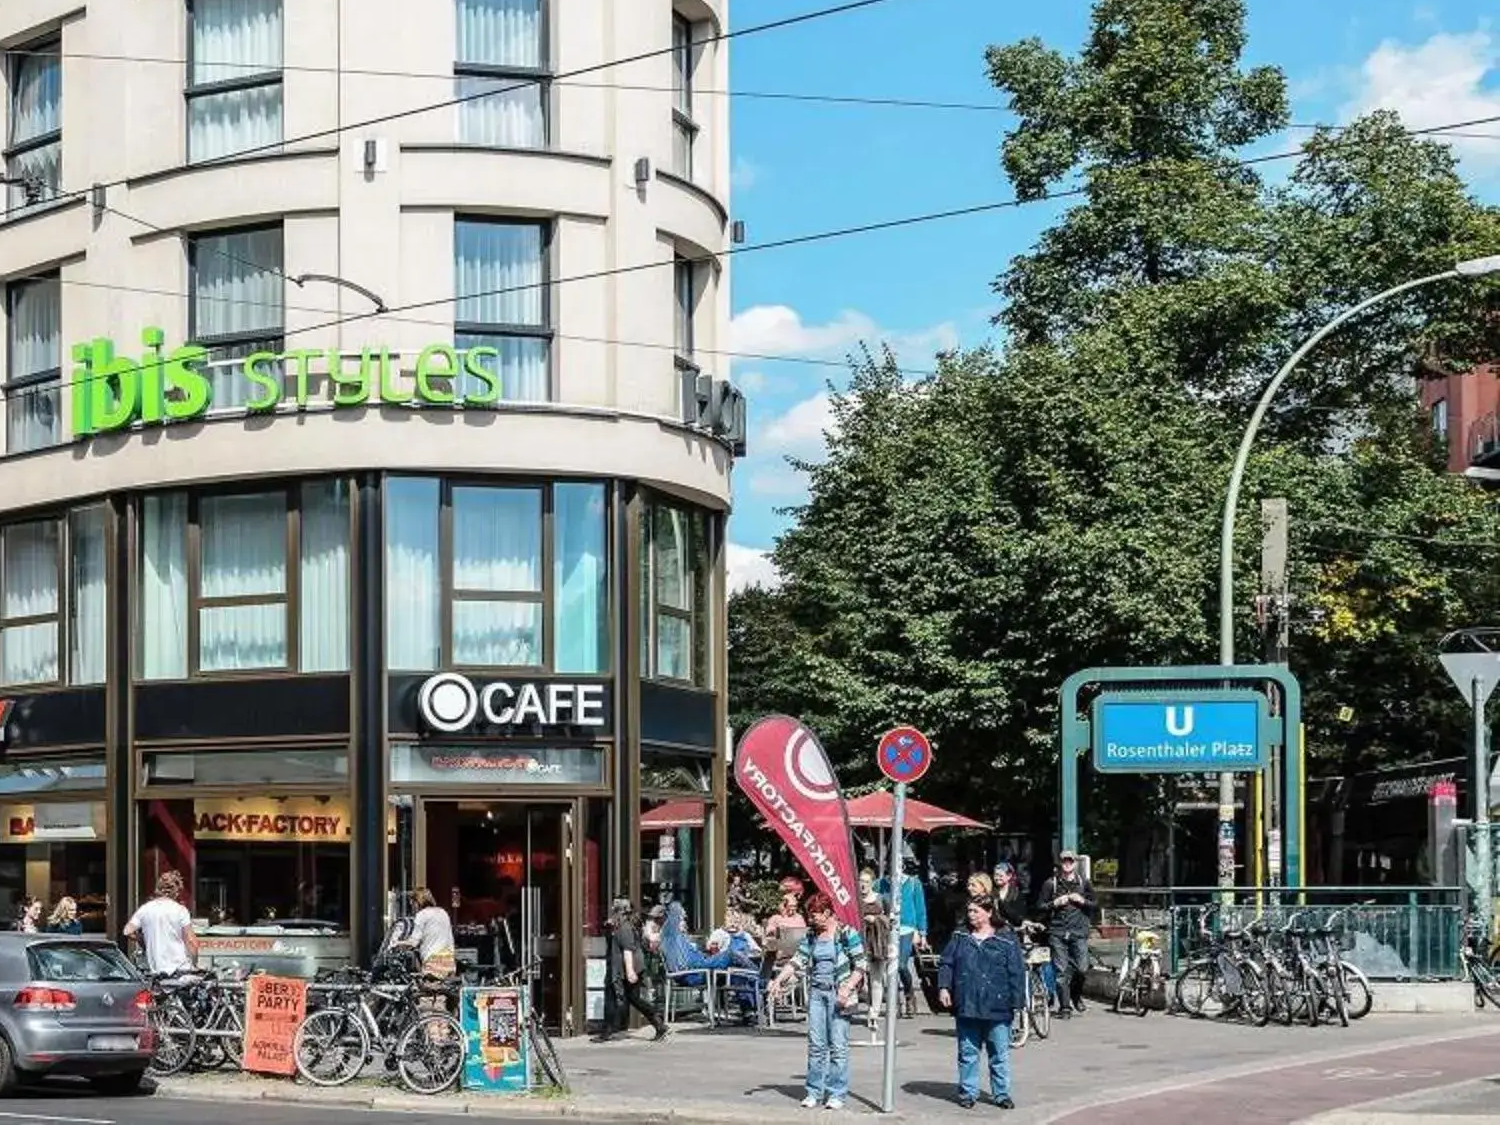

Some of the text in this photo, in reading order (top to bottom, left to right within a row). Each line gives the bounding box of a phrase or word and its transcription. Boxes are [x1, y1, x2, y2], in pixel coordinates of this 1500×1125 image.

[71, 325, 212, 437] ibis
[480, 682, 604, 725] CAFE
[1166, 706, 1194, 736] U
[1107, 740, 1254, 758] Rosenthaler Platz
[257, 995, 301, 1012] PARTY
